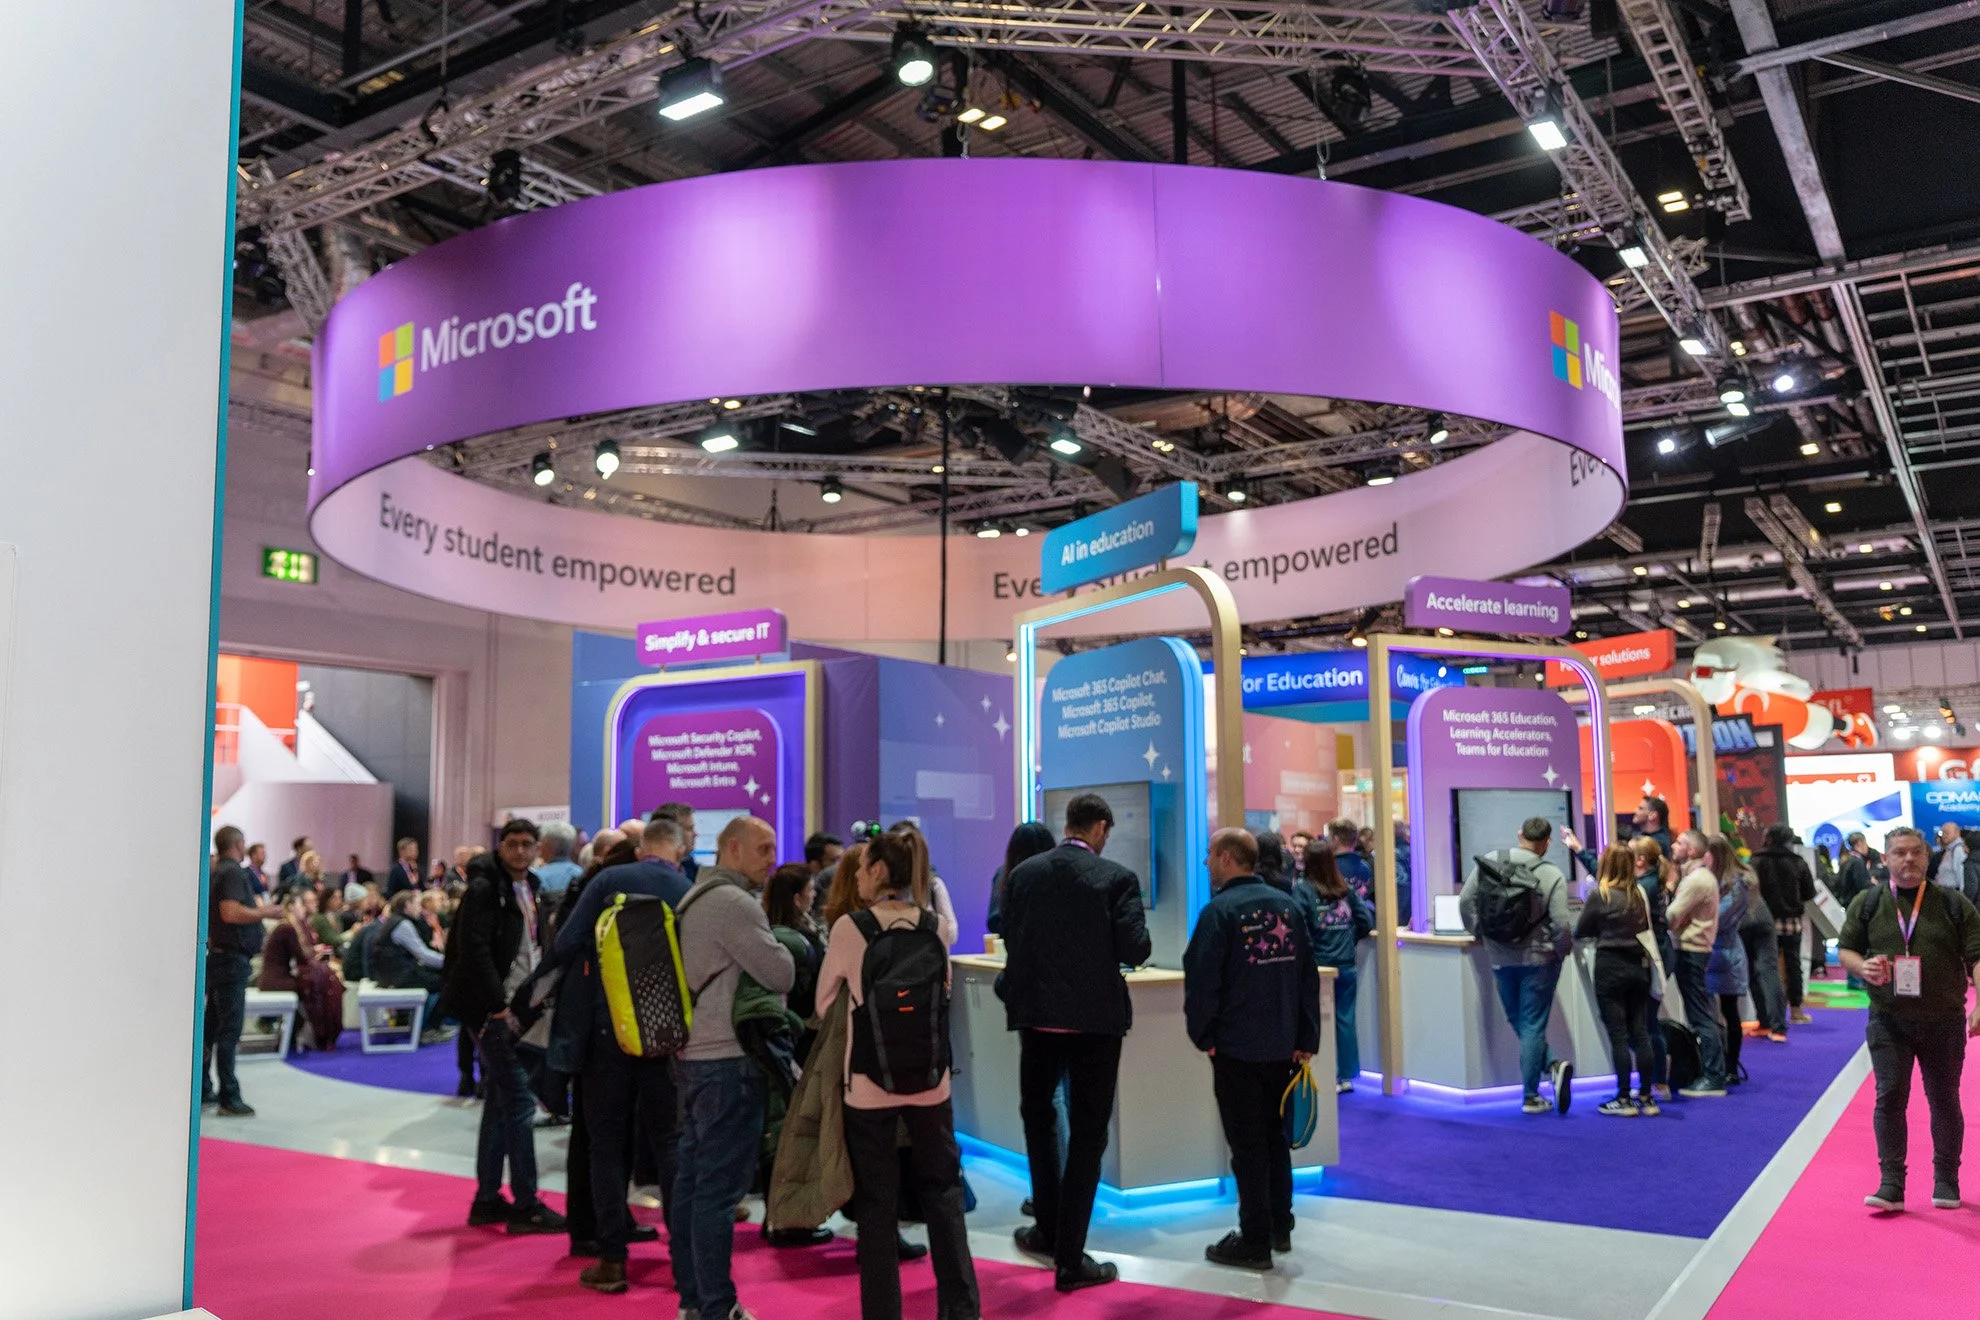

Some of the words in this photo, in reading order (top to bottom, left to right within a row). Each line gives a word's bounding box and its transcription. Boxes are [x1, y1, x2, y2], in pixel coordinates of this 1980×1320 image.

[421, 282, 597, 372] Microsoft
[379, 492, 439, 554] Every
[444, 525, 544, 574] student
[552, 553, 737, 596] empowered
[1061, 545, 1075, 566] AI
[1076, 540, 1088, 562] in
[1089, 520, 1154, 556] education
[1224, 522, 1398, 584] empowered
[1426, 592, 1501, 615] Accelerate
[1504, 598, 1559, 624] learning
[645, 630, 696, 653] Simplify
[697, 629, 709, 646] &
[711, 627, 755, 645] secure
[756, 622, 771, 640] IT
[1600, 648, 1651, 667] solutions
[1052, 682, 1091, 702] Microsoft
[1092, 679, 1107, 696] 365
[1108, 674, 1140, 693] Copilot
[1142, 670, 1167, 686] Chat,
[1267, 668, 1363, 692] Education
[1062, 700, 1102, 719] Microsoft
[1103, 697, 1118, 713] 365
[1120, 692, 1155, 711] Copilot,
[1443, 709, 1490, 723] Microsoft
[1491, 711, 1509, 724] 365
[1510, 711, 1558, 727] Education,
[1058, 720, 1097, 739] Microsoft
[1098, 716, 1130, 735] Copilot
[1131, 711, 1162, 729] Studio
[1450, 726, 1491, 742] Learning
[1493, 727, 1553, 742] Accelerators,
[648, 732, 689, 747] Microsoft
[690, 732, 725, 746] Security
[1455, 742, 1486, 756] Teams
[1487, 743, 1501, 756] for
[1502, 743, 1549, 757] Education
[651, 747, 692, 761] Microsoft
[666, 760, 708, 774] Microsoft
[669, 775, 711, 789] Microsoft
